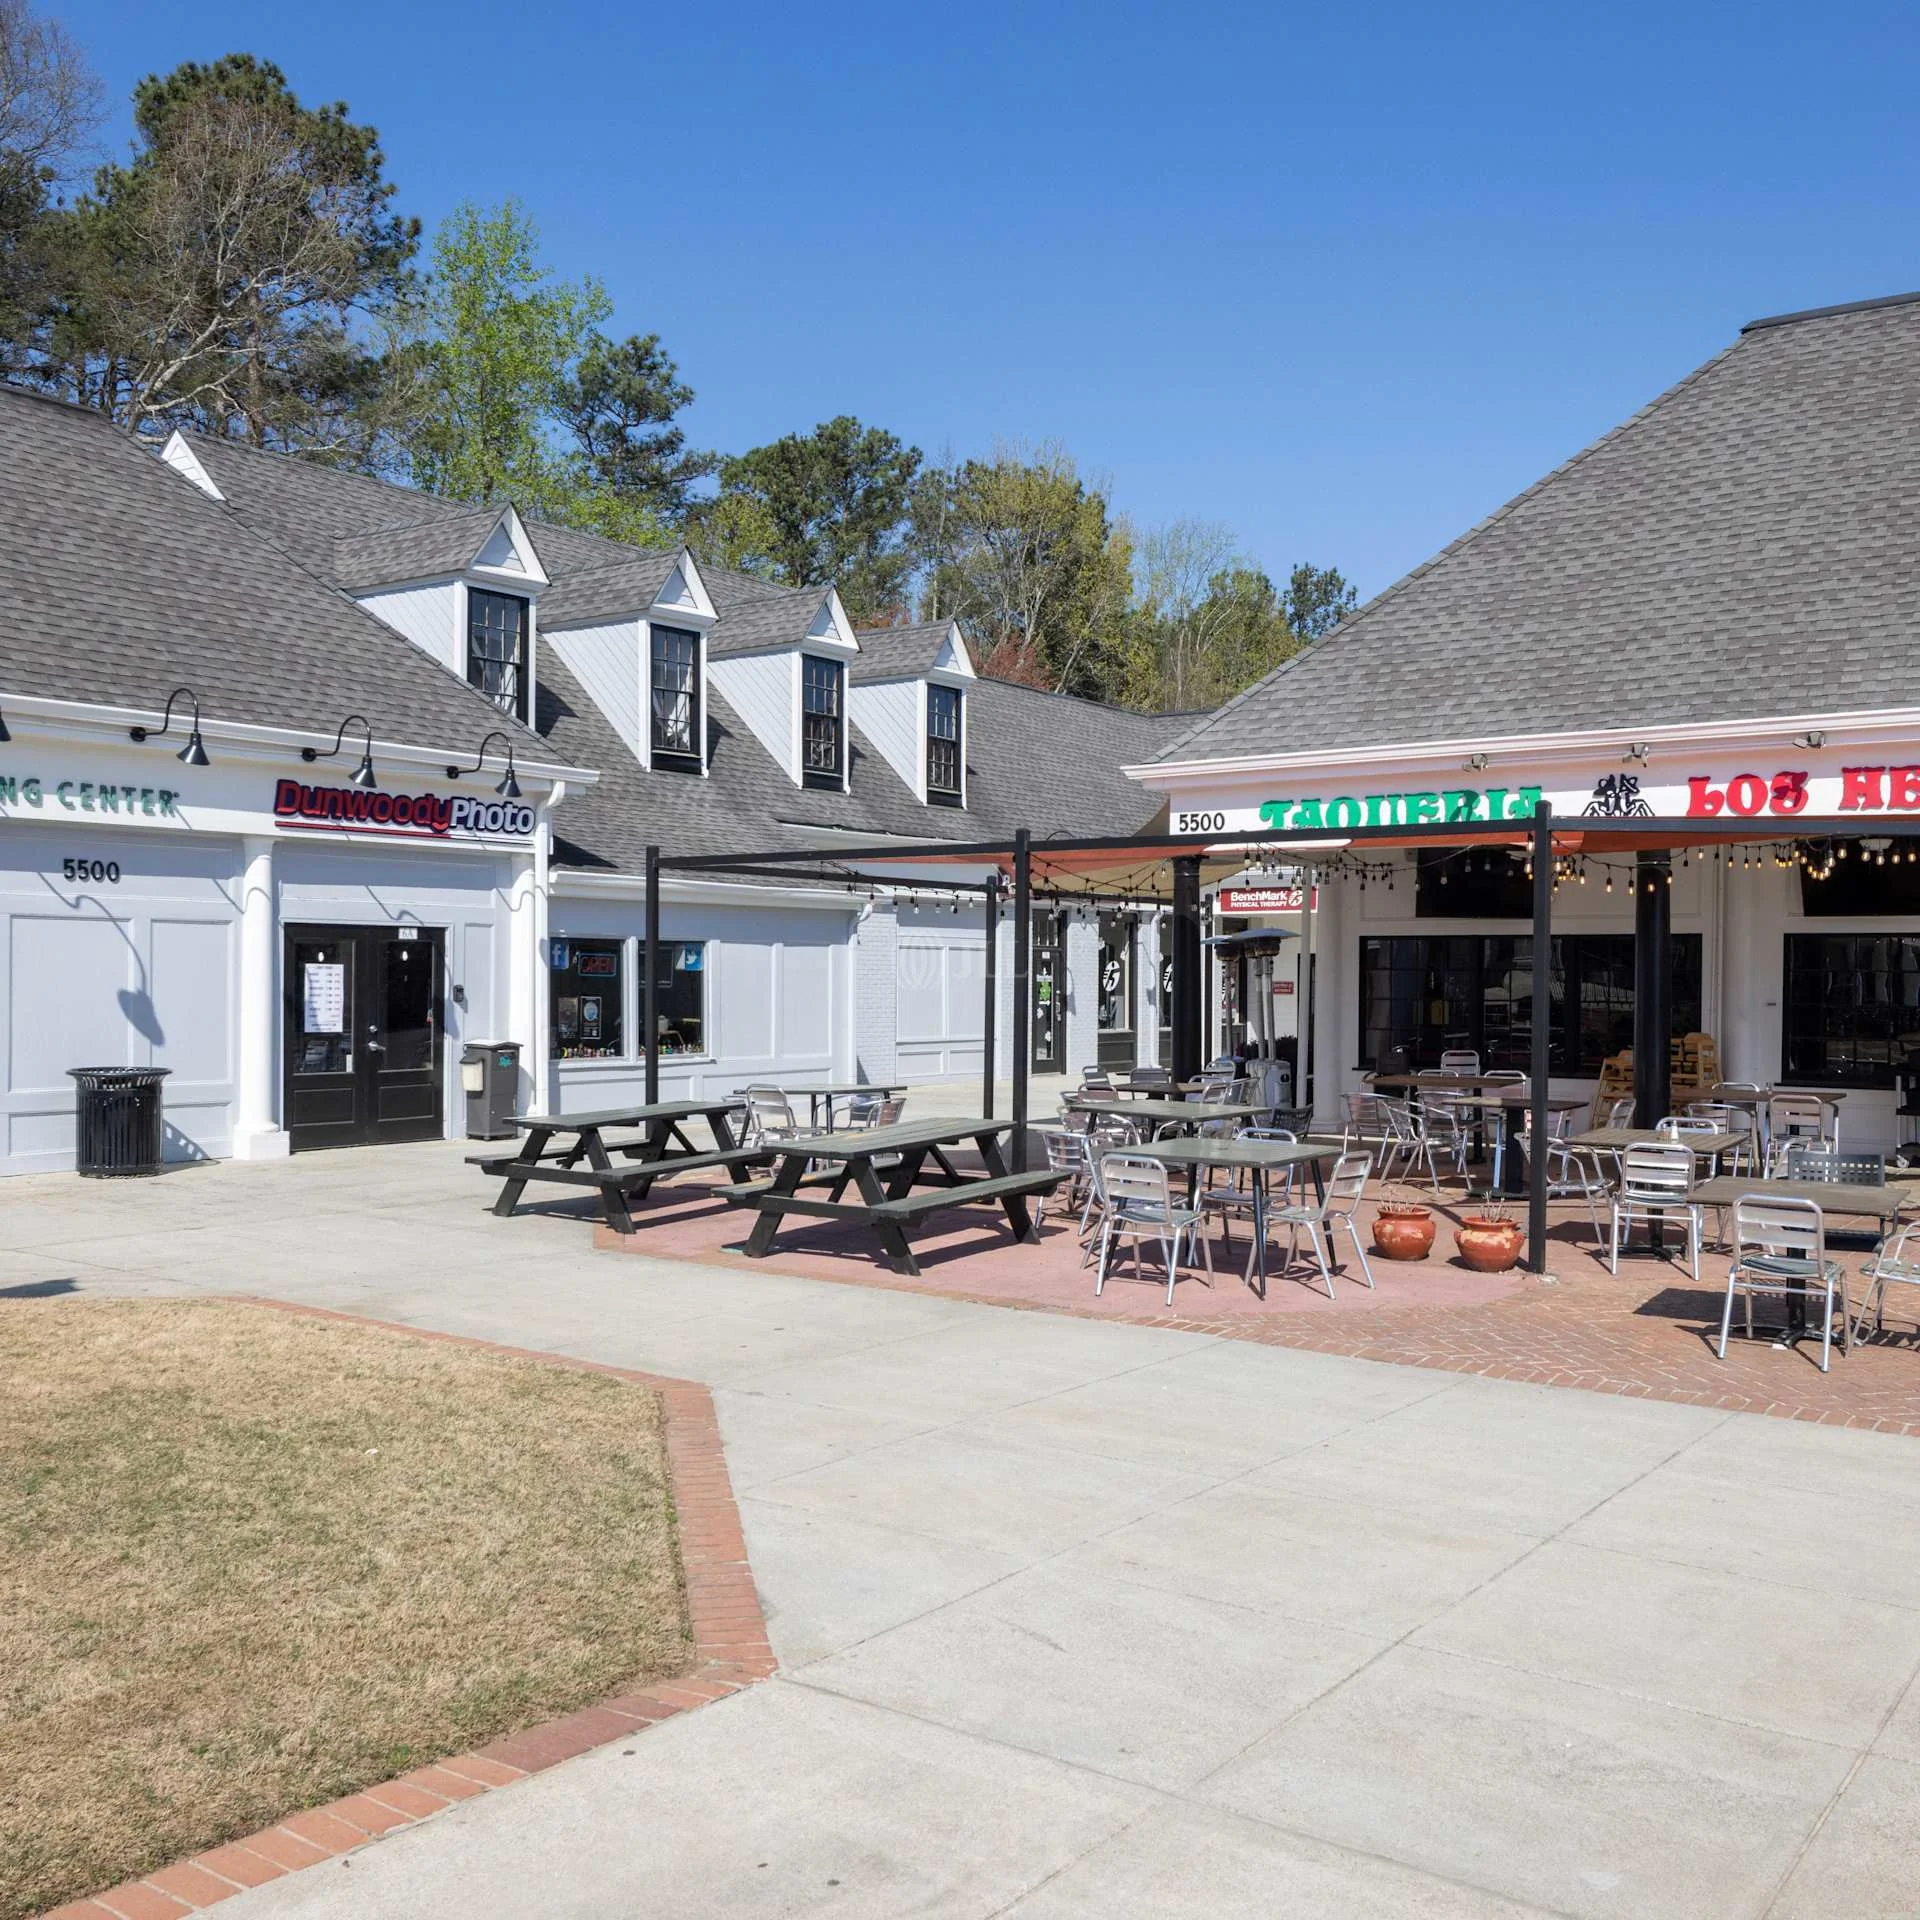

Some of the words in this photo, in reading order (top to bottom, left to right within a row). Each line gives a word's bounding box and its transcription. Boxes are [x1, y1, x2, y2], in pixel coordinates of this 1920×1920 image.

[1179, 812, 1225, 832] 5500
[63, 858, 120, 883] 5500
[1230, 890, 1288, 902] BenchMark
